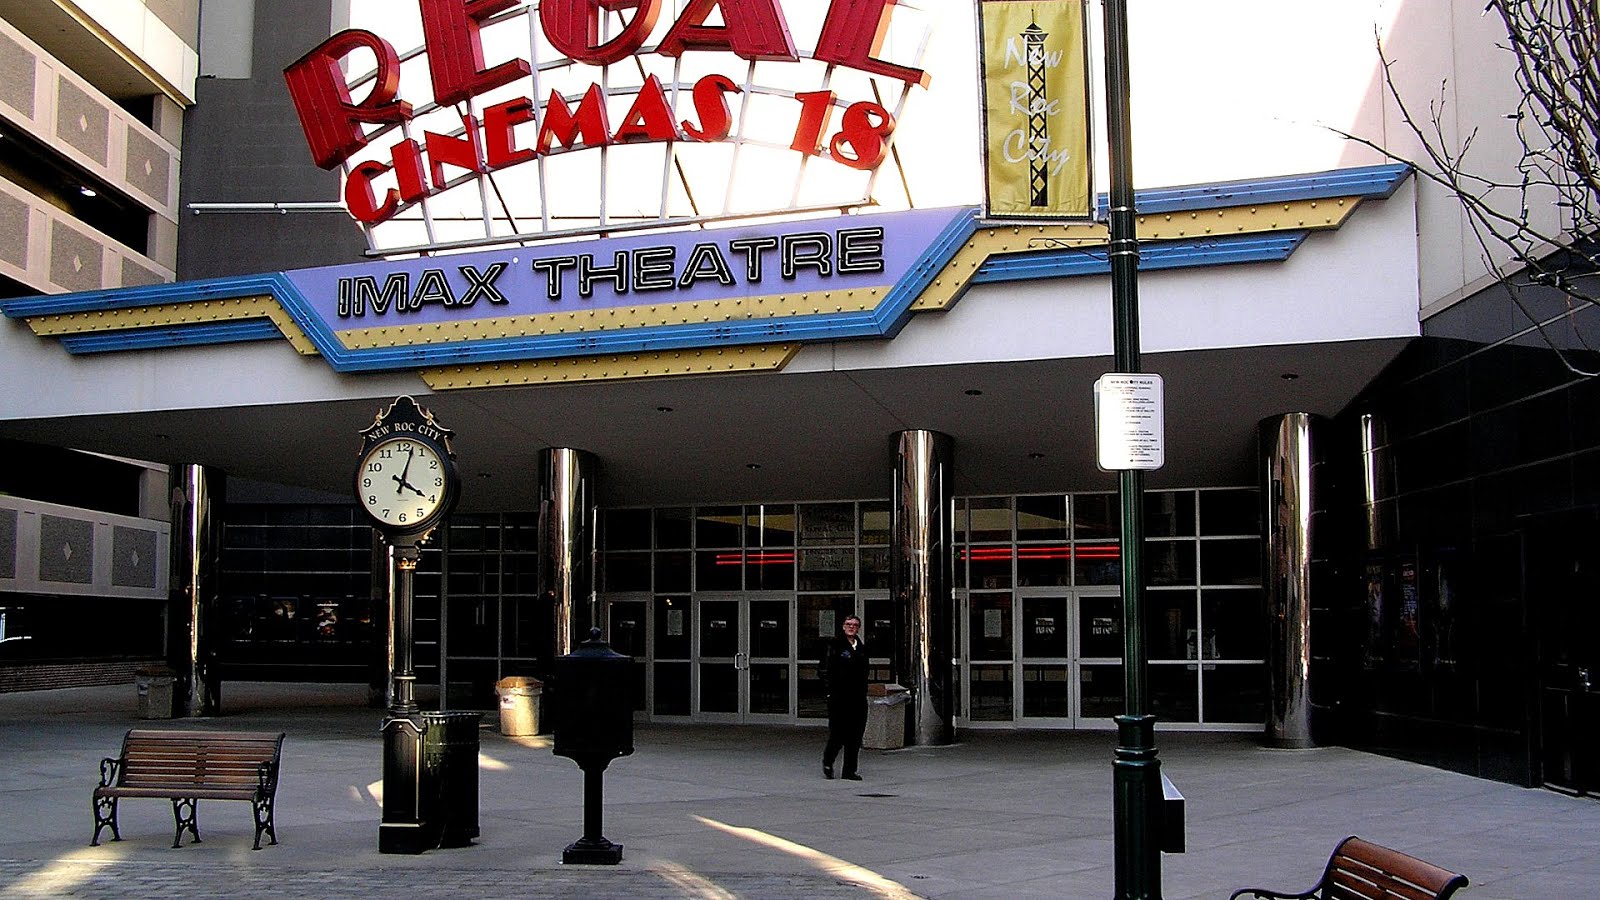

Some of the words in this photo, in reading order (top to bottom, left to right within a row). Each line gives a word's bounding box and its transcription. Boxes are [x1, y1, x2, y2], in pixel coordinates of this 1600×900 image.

[1004, 35, 1063, 69] New
[1009, 81, 1061, 117] Roc
[345, 73, 744, 224] CINEMAS
[789, 90, 897, 171] 18
[1003, 129, 1070, 177] City
[338, 261, 509, 318] IMAX
[532, 226, 885, 299] THEATRE
[368, 425, 390, 441] NEW
[394, 422, 416, 432] ROC
[418, 424, 441, 440] CITY
[396, 443, 411, 452] 12
[418, 448, 425, 457] 1
[379, 449, 393, 459] 11
[368, 462, 382, 472] 10
[429, 460, 438, 470] 2
[363, 478, 372, 487] 9
[434, 477, 443, 487] 3
[368, 495, 377, 505] 8
[428, 494, 436, 504] 4
[382, 509, 390, 519] 7
[398, 513, 407, 522] 6
[416, 508, 424, 518] 5
